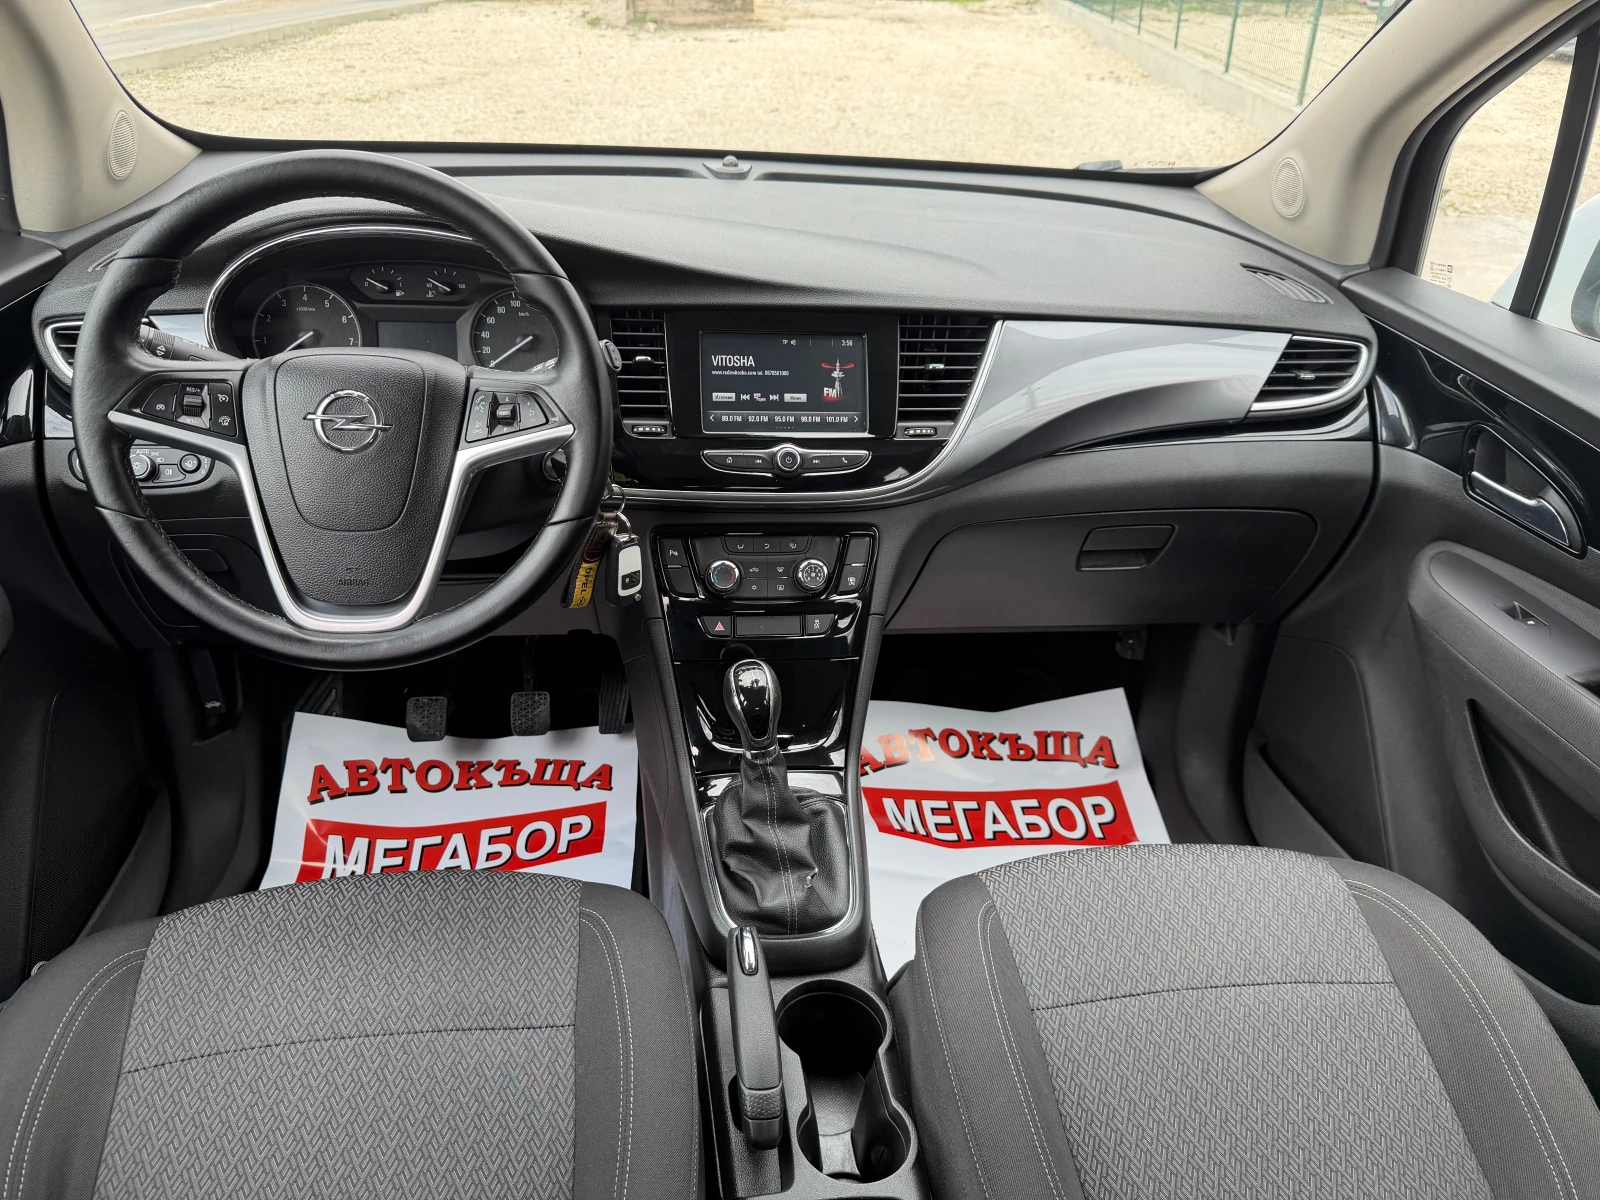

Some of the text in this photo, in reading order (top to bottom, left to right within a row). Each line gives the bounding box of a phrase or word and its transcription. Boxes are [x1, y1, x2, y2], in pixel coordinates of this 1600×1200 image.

[302, 293, 308, 302] 4
[281, 299, 287, 307] 3
[324, 300, 330, 308] 5
[510, 300, 521, 308] 100
[497, 306, 506, 314] 80
[266, 314, 272, 323] 2
[341, 315, 348, 324] 6
[486, 316, 496, 324] 60
[480, 331, 490, 339] 40
[348, 337, 354, 346] 7
[482, 346, 491, 354] 20
[711, 354, 756, 367] VITOSHA
[823, 387, 837, 398] FM
[337, 578, 370, 587] AIRBAG
[580, 567, 593, 596] OPEL
[860, 728, 1120, 778] АВТОКЪЩА
[307, 757, 614, 805] АВТОКЪЩА
[882, 795, 1118, 842] МЕГАБОР
[322, 814, 594, 876] МЕГАБОР
